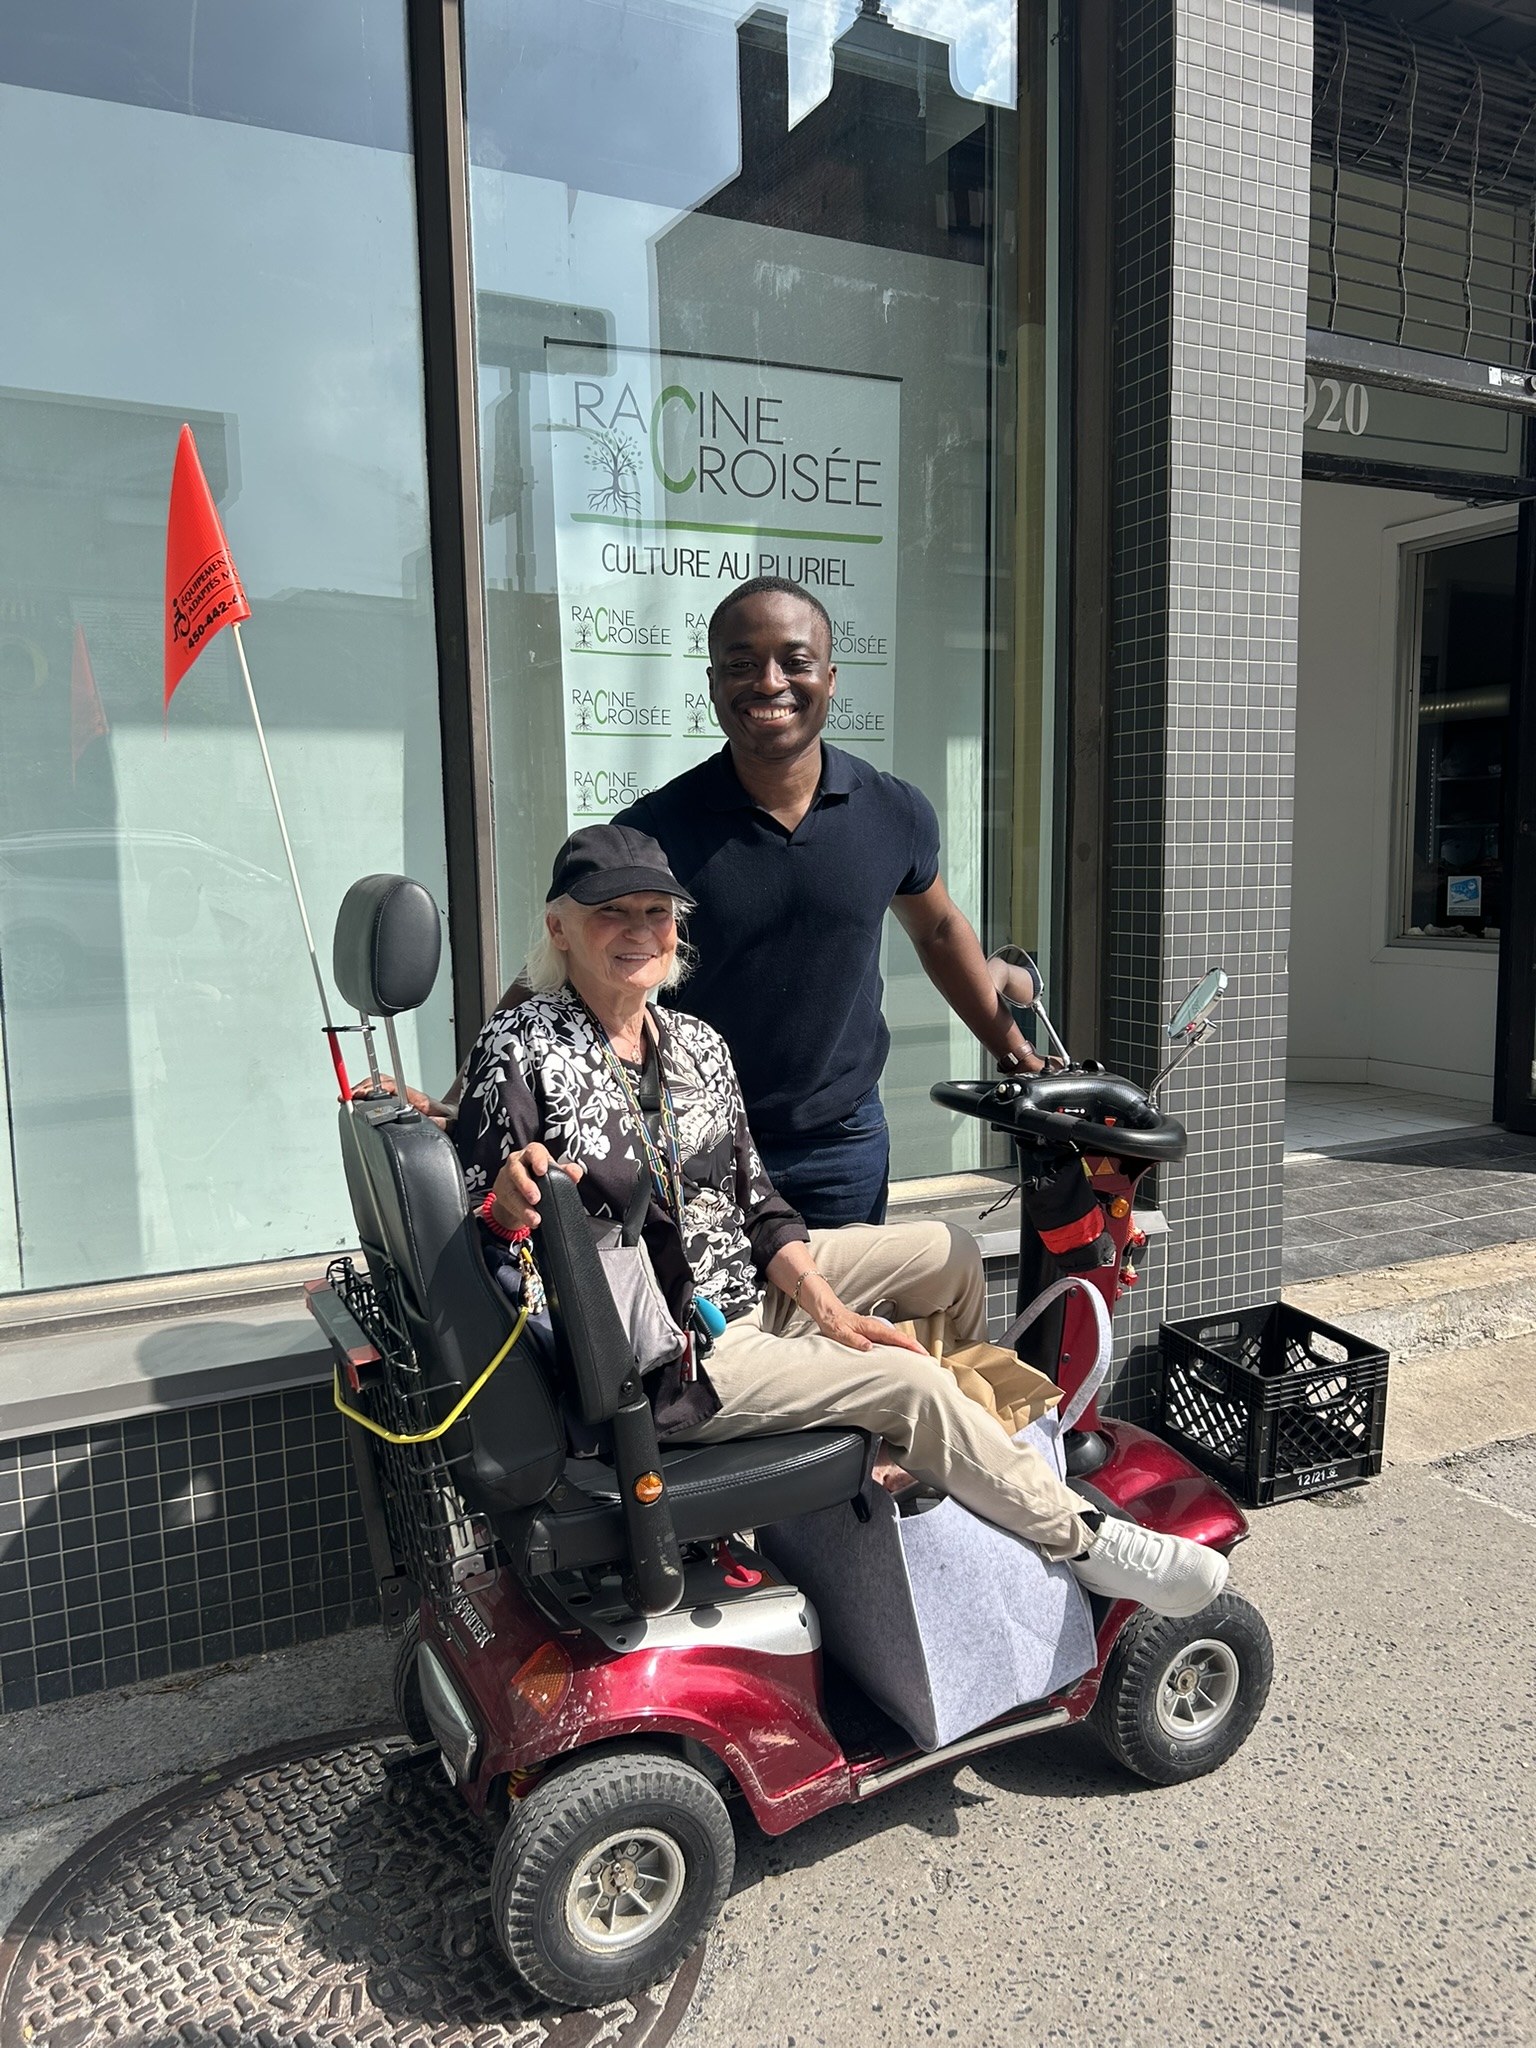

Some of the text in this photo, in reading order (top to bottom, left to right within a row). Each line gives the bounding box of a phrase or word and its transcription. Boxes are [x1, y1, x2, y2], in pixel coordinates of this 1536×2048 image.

[574, 381, 784, 494] RACINE
[602, 543, 711, 579] CULTURE
[717, 551, 750, 581] AU
[571, 605, 636, 643] RACINE
[831, 635, 888, 655] ROISÉE
[572, 689, 637, 725] RACINE
[827, 712, 886, 731] ROISÉE
[574, 770, 638, 805] RACINE
[1297, 1469, 1326, 1486] 12/21
